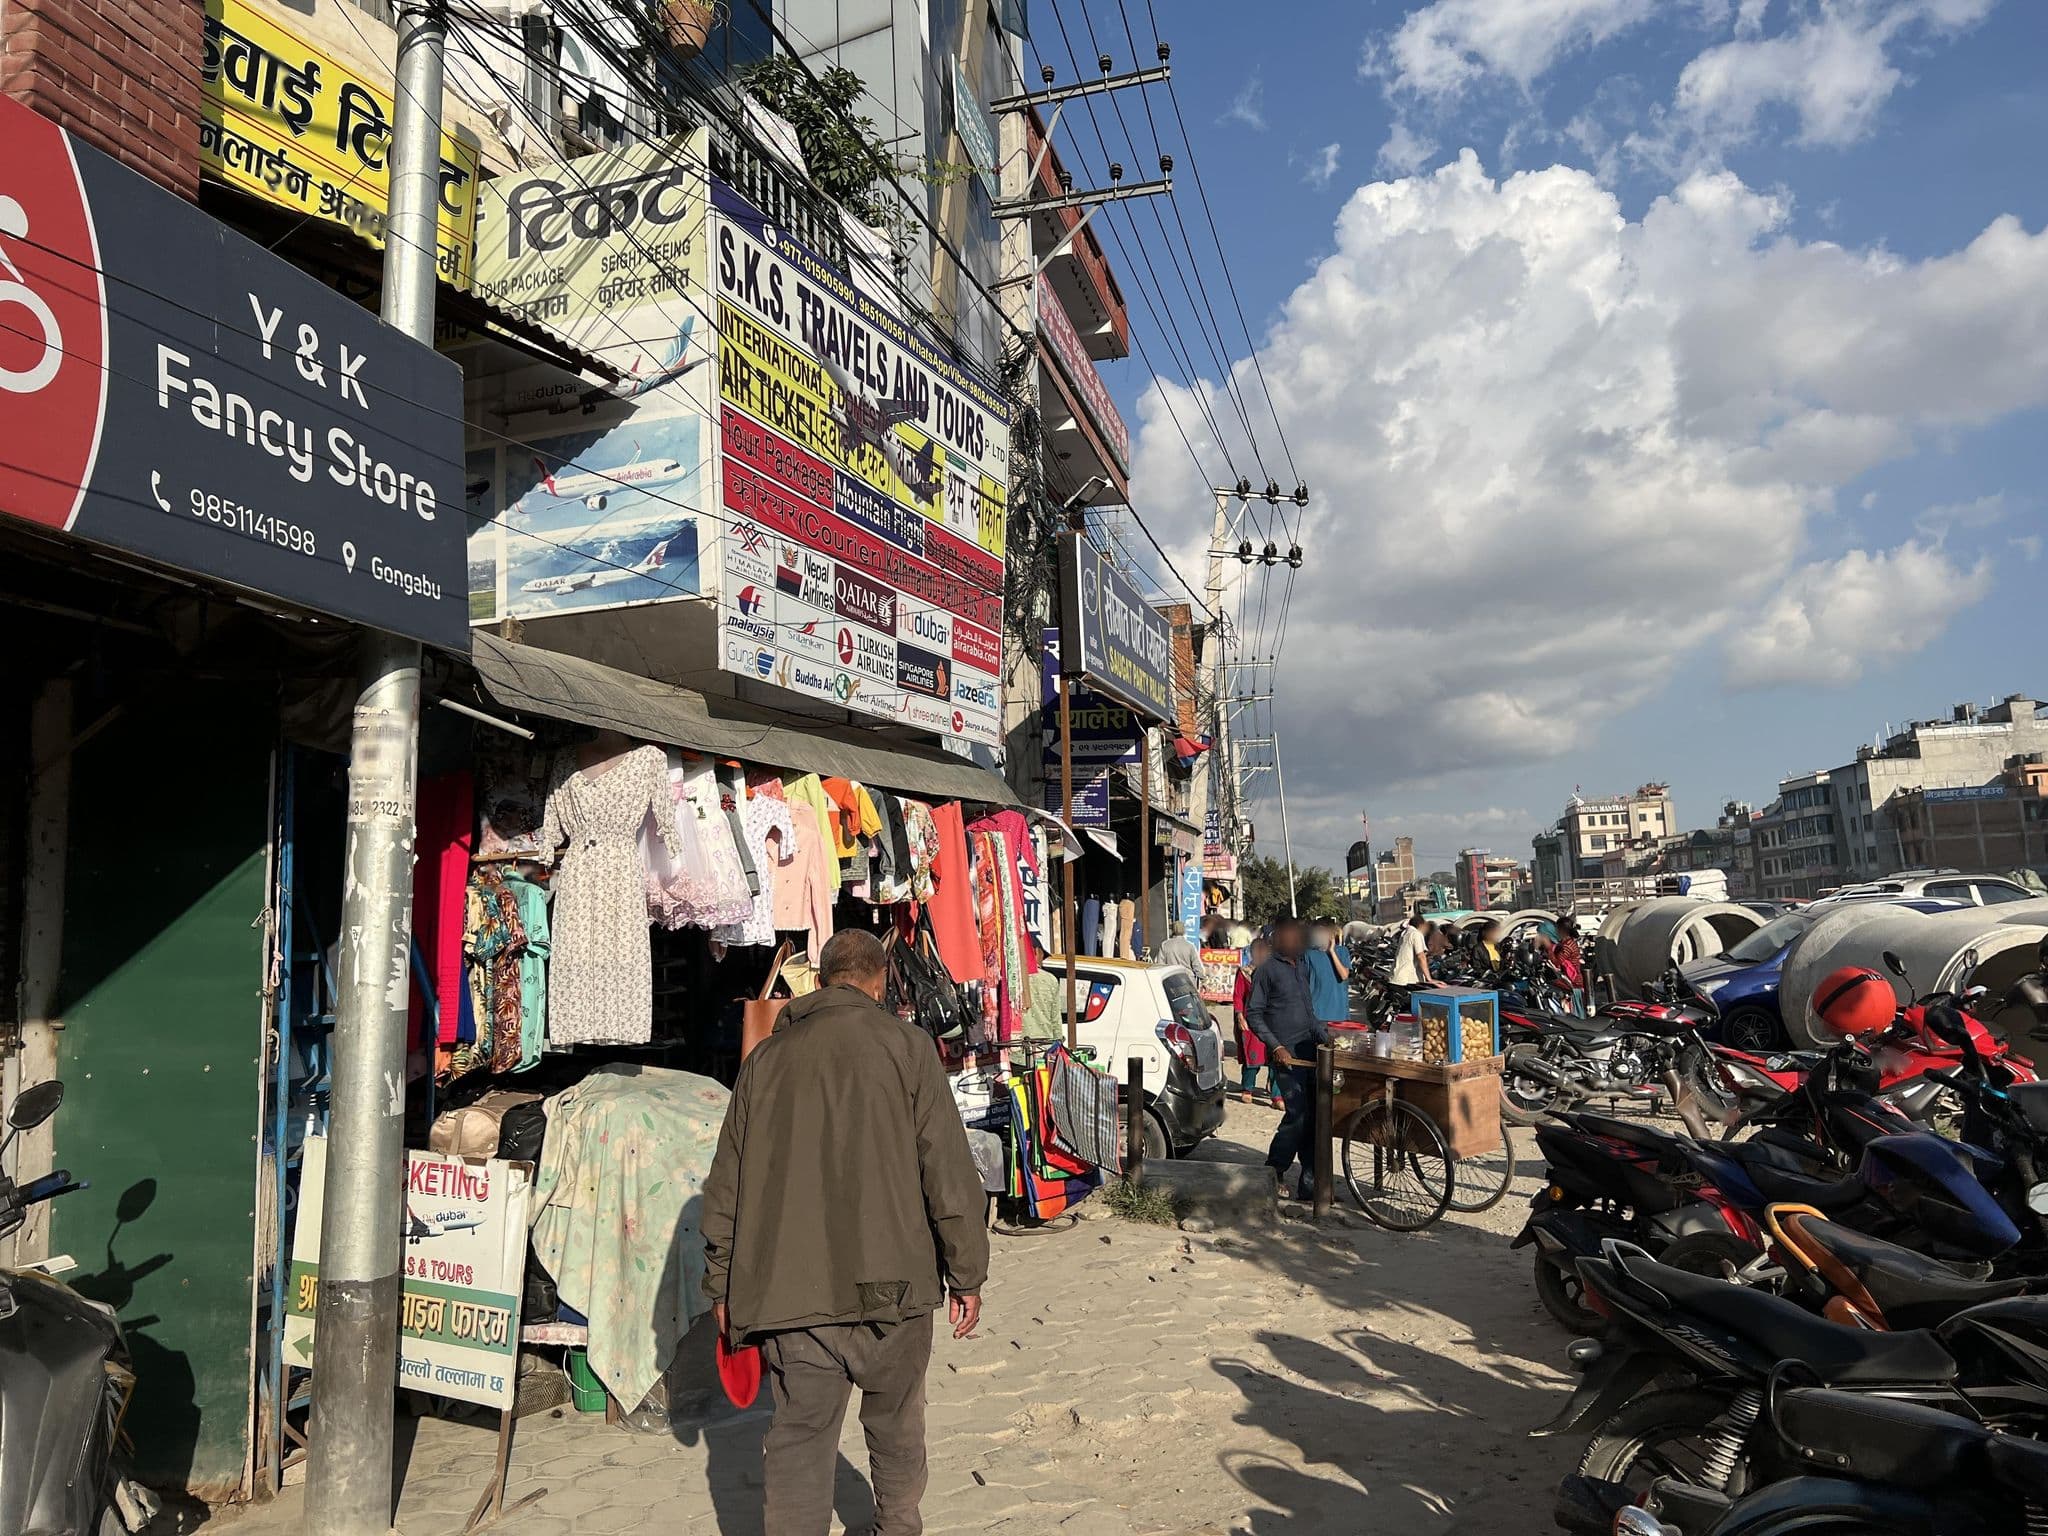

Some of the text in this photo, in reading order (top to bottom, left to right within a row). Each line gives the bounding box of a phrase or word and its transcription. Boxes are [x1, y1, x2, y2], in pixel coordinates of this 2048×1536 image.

[200, 120, 312, 203] नलाईन
[336, 82, 469, 218] टिट
[506, 163, 694, 260] टिकट
[511, 266, 565, 292] PACKAGE
[859, 297, 907, 344] 9851100561
[248, 292, 370, 409] Y & K
[720, 225, 790, 332] S.K.S.
[797, 281, 888, 397] TRAVELS
[893, 354, 930, 423] AND
[934, 384, 984, 462] TOURS
[992, 443, 1005, 463] LTD
[720, 303, 826, 398] INTERNATIONAL
[721, 347, 752, 409] AIR
[157, 344, 437, 522] Fancy Store
[723, 411, 833, 499] Tour Packages
[190, 488, 316, 557] 9851141598
[836, 474, 924, 549] Mountain Flight
[727, 555, 774, 578] HIMALAYA
[804, 552, 830, 584] Nepal
[925, 530, 958, 570] Sight
[371, 555, 441, 601] Gongabu
[534, 578, 566, 589] QATAR
[735, 565, 767, 582] AIRLINES
[802, 580, 834, 611] Airlines
[835, 577, 877, 614] QATAR
[728, 615, 775, 641] malaysia
[727, 641, 755, 666] Guna
[857, 634, 894, 663] TURKISH
[857, 653, 895, 681] AIRLINES
[953, 638, 998, 666] airarabia.com
[795, 668, 835, 692] Buddha Air
[855, 690, 869, 702] Yeti
[870, 692, 897, 714] Airlines
[980, 725, 997, 737] Airlines
[402, 1159, 490, 1202] KETING
[418, 1258, 428, 1279] &
[431, 1260, 474, 1286] TOURS
[451, 1300, 512, 1347] फारम
[435, 1364, 487, 1390] तल्लामा
[490, 1375, 505, 1394] छ
